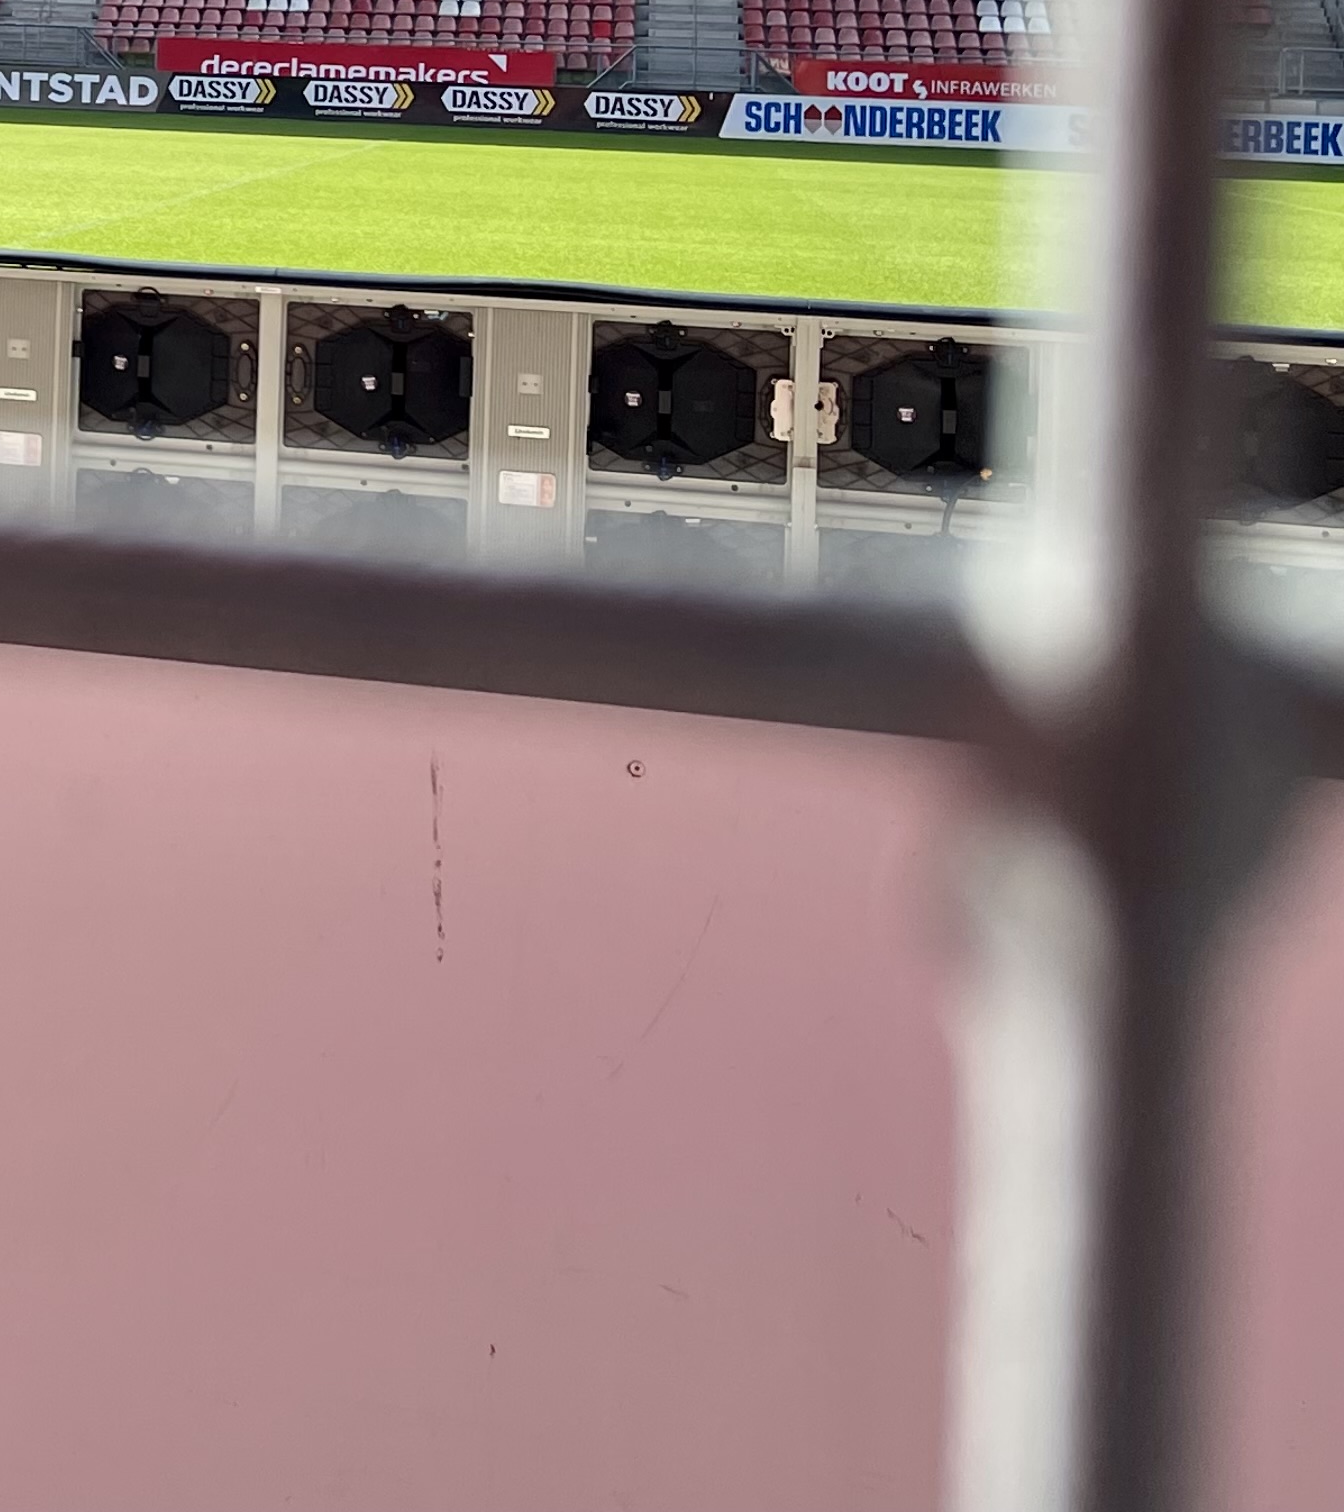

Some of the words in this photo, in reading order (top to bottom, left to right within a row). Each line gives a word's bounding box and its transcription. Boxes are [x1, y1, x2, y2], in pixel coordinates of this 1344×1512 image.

[178, 79, 251, 99] DASSY
[314, 84, 389, 104] DASSY
[826, 71, 909, 93] KOOT
[931, 79, 1056, 99] INFRAWERKEN
[452, 89, 529, 111] DASSY
[595, 96, 674, 118] DASSY
